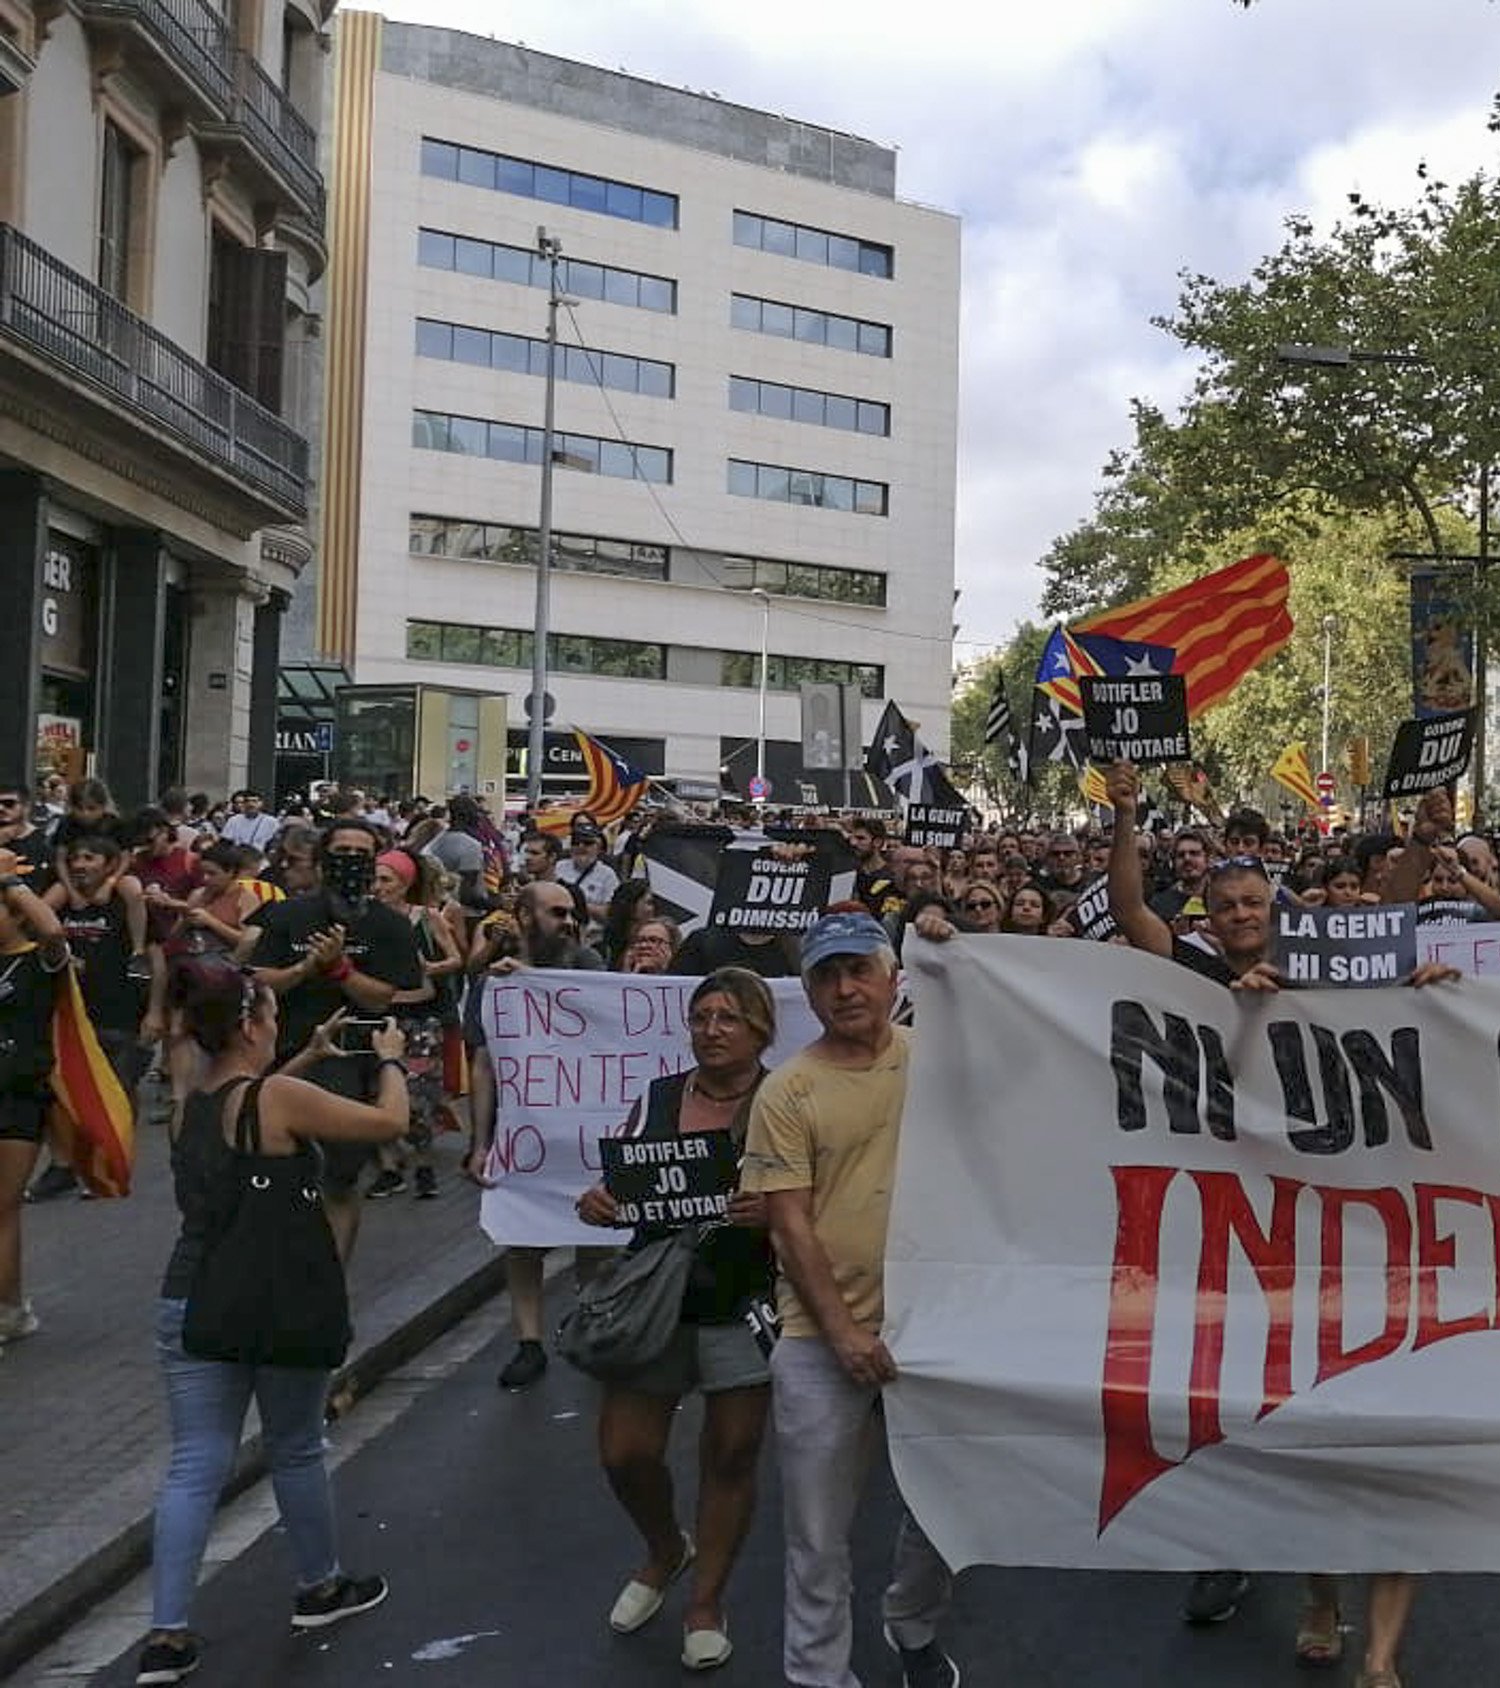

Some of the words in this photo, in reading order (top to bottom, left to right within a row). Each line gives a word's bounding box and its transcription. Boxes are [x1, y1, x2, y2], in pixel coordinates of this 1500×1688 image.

[1111, 707, 1139, 735] JO
[1119, 732, 1187, 760] VOTARÉ
[1419, 732, 1463, 768] DUI
[910, 806, 926, 823] LA
[928, 809, 964, 826] GENT
[926, 831, 956, 849] SOM
[746, 875, 806, 905] DUI
[1078, 887, 1109, 925] DU
[1279, 912, 1318, 938] LA
[1326, 911, 1405, 939] GENT
[1288, 952, 1320, 980] HI
[1329, 952, 1397, 982] SOM
[494, 985, 587, 1040] ENS
[1110, 1000, 1238, 1142] NI
[1267, 1019, 1434, 1155] UN
[622, 1138, 709, 1165] BOTIFLER
[655, 1165, 688, 1195] JO
[643, 1201, 664, 1221] ET
